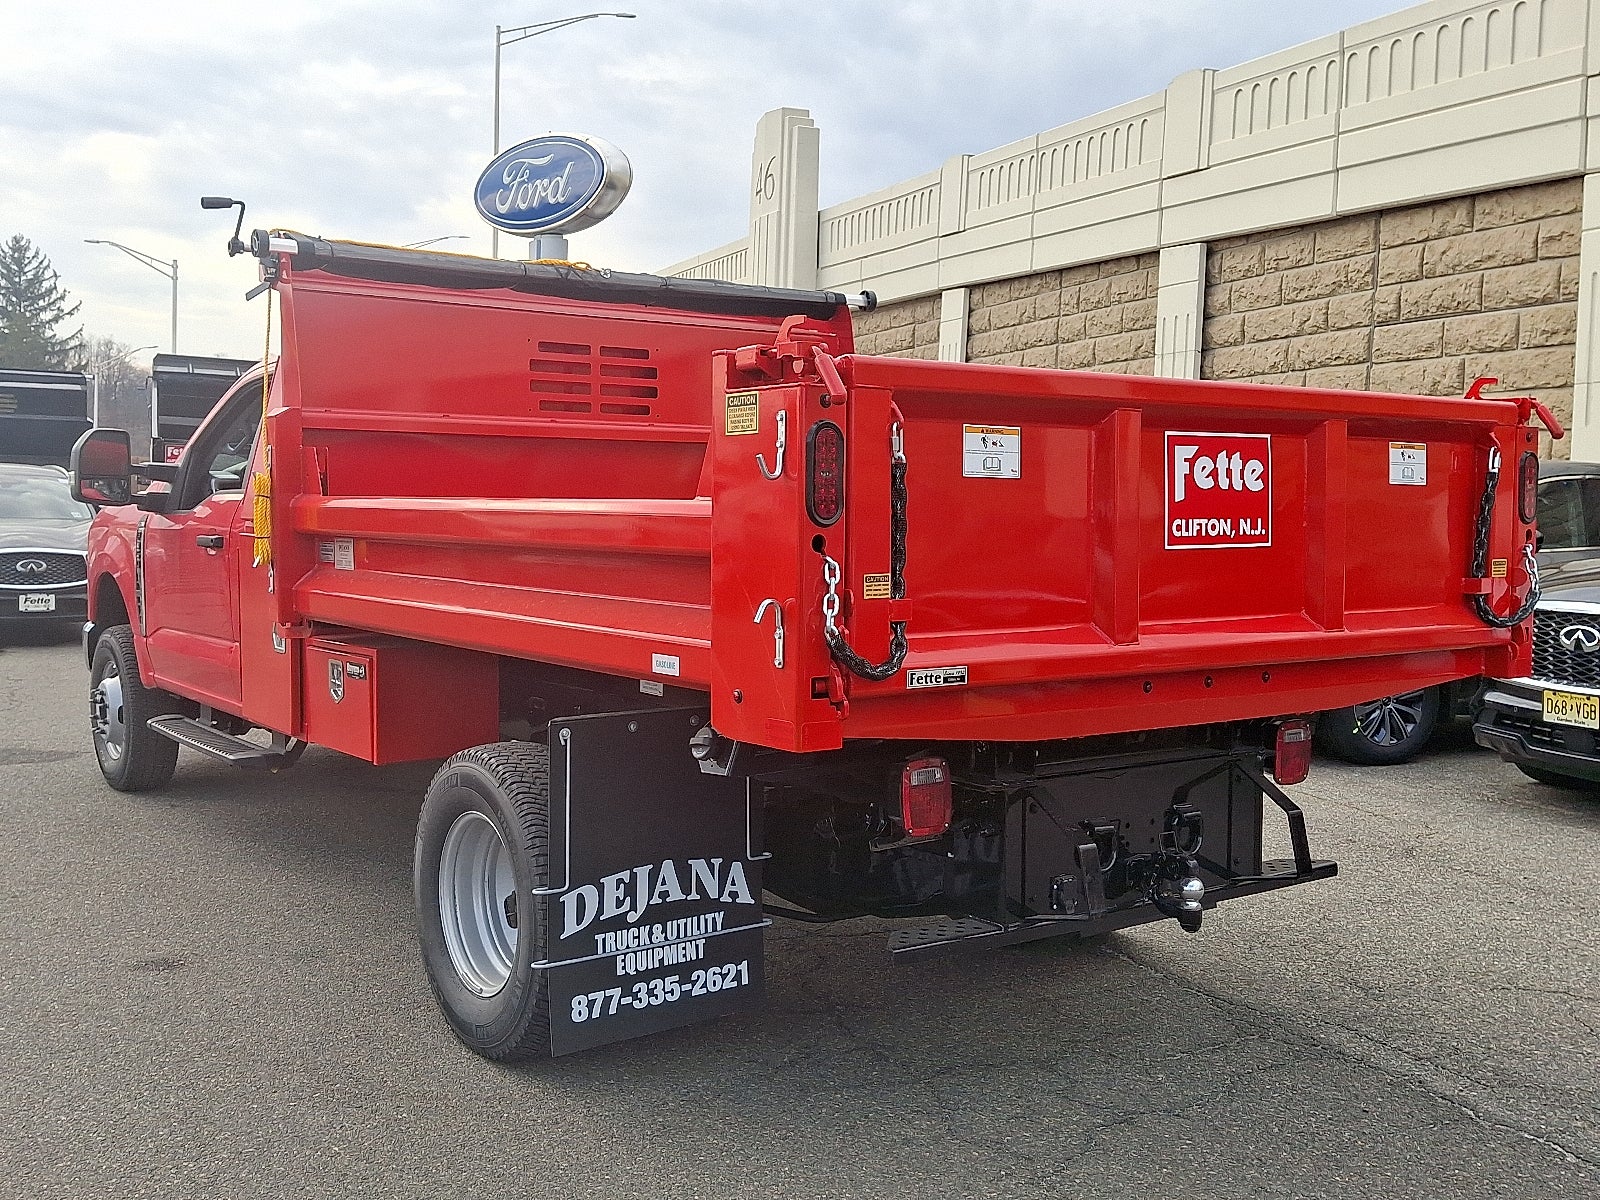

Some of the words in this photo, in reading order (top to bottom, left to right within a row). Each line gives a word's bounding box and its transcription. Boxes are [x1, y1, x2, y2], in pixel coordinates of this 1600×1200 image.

[495, 153, 575, 214] Ford
[755, 155, 776, 205] 46
[728, 395, 756, 406] CAUTION
[1174, 445, 1265, 502] Fette
[1172, 518, 1236, 538] CLIFTON,
[1239, 518, 1266, 535] N.J.
[655, 660, 676, 670] GASOLINE
[909, 672, 942, 686] Fette
[559, 857, 755, 940] DEJANA
[616, 939, 706, 976] EQUIPMENT
[570, 960, 749, 1023] 877-335-2621
